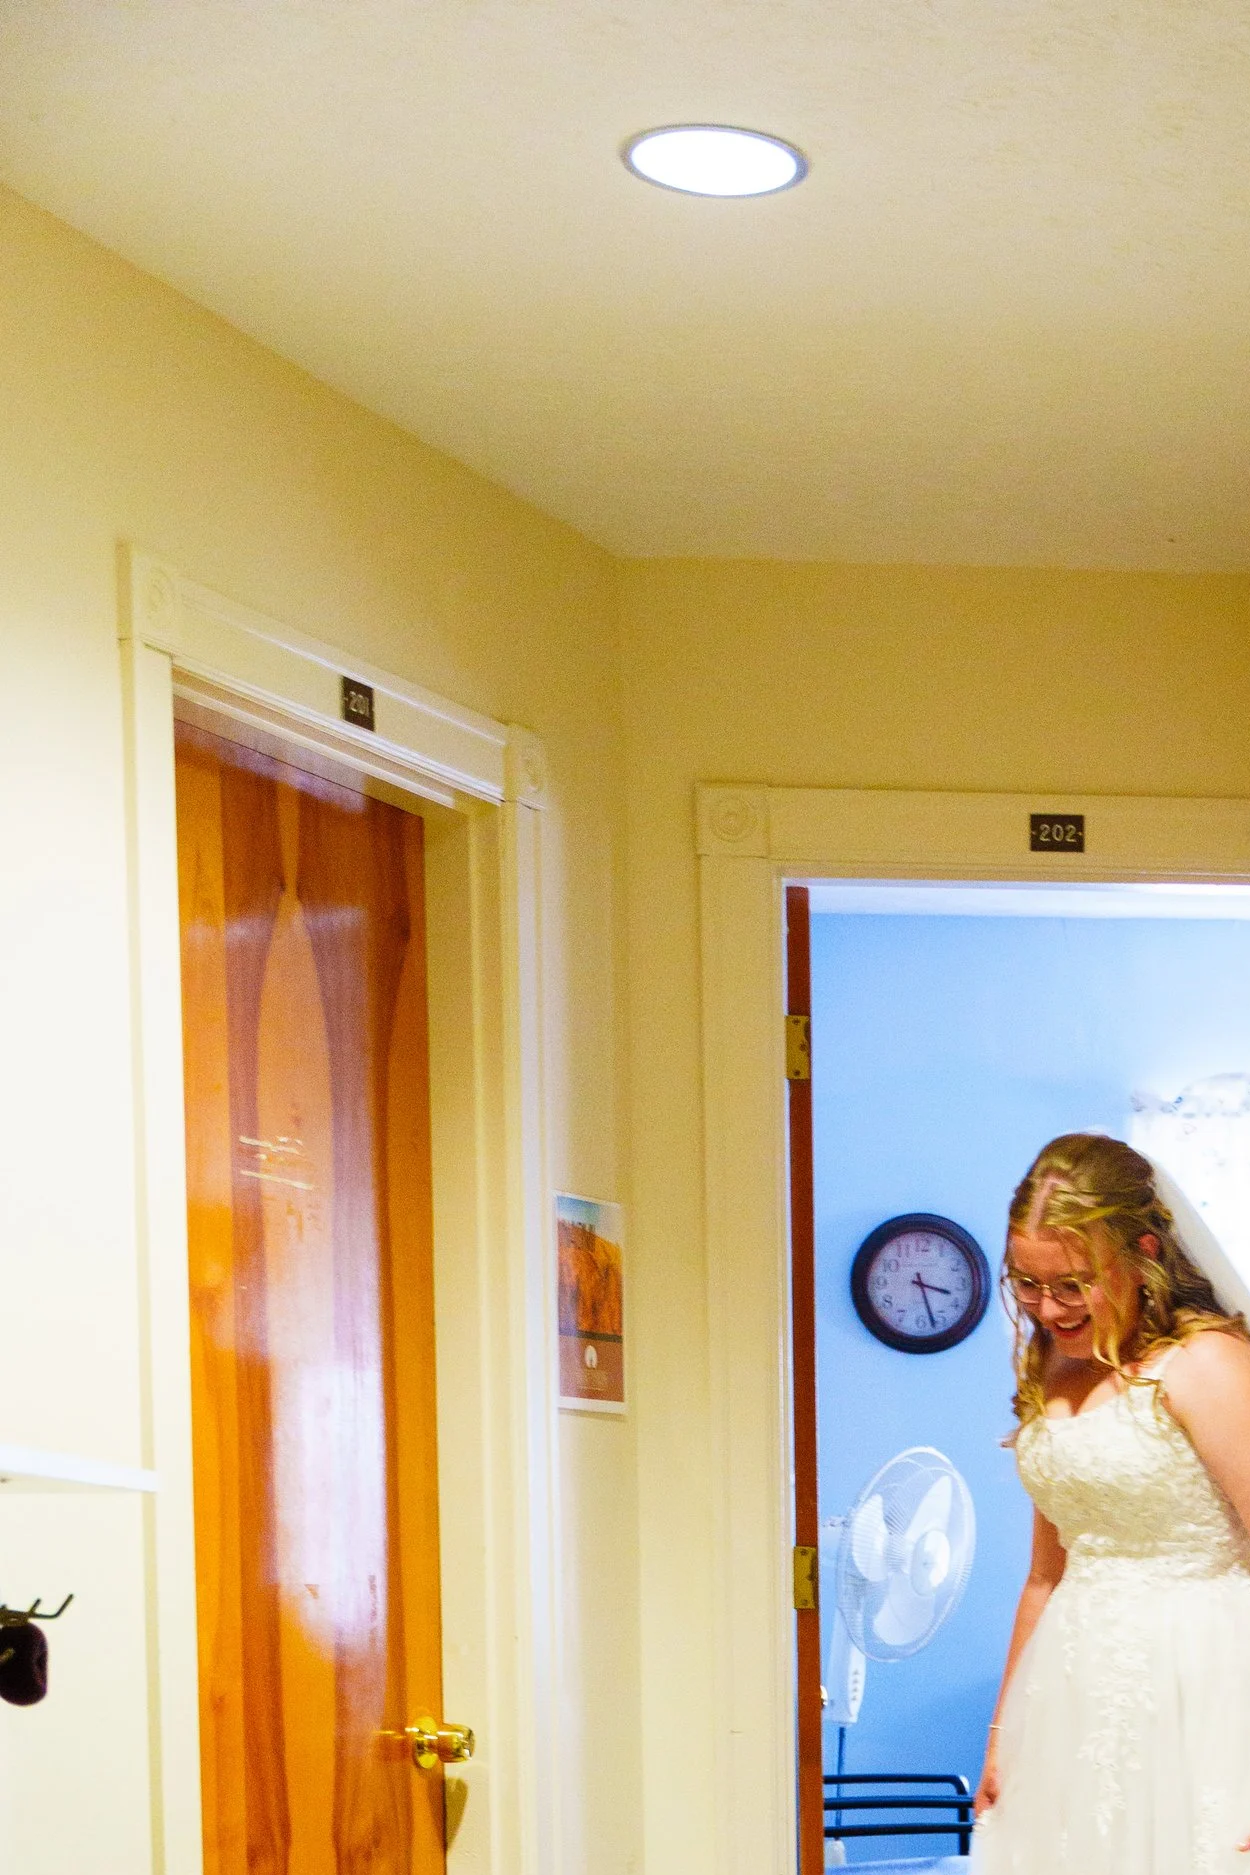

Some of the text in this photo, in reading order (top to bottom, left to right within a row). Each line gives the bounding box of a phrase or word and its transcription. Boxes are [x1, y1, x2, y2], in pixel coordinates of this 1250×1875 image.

[1039, 824, 1077, 843] 202
[896, 1243, 910, 1258] 11
[915, 1238, 930, 1252] 12
[883, 1258, 900, 1273] 10
[876, 1276, 888, 1290] 9
[956, 1276, 967, 1290] 3
[882, 1294, 894, 1309] 8
[950, 1297, 960, 1310] 4
[896, 1309, 907, 1323] 7
[915, 1315, 926, 1329] 6
